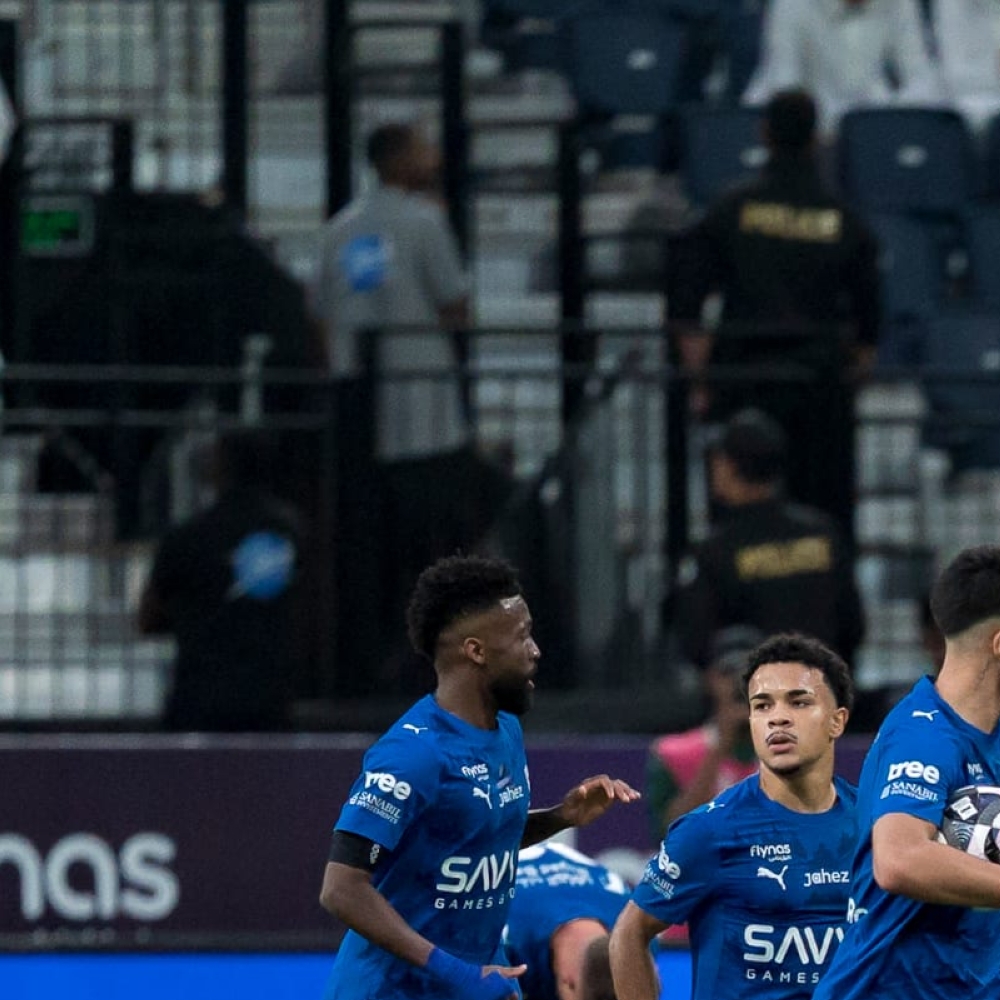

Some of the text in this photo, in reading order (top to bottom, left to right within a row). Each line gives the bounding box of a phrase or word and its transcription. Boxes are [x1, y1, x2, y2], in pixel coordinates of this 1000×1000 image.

[750, 843, 791, 859] flynas
[434, 896, 495, 911] GAMES
[745, 967, 821, 985] GAMES
